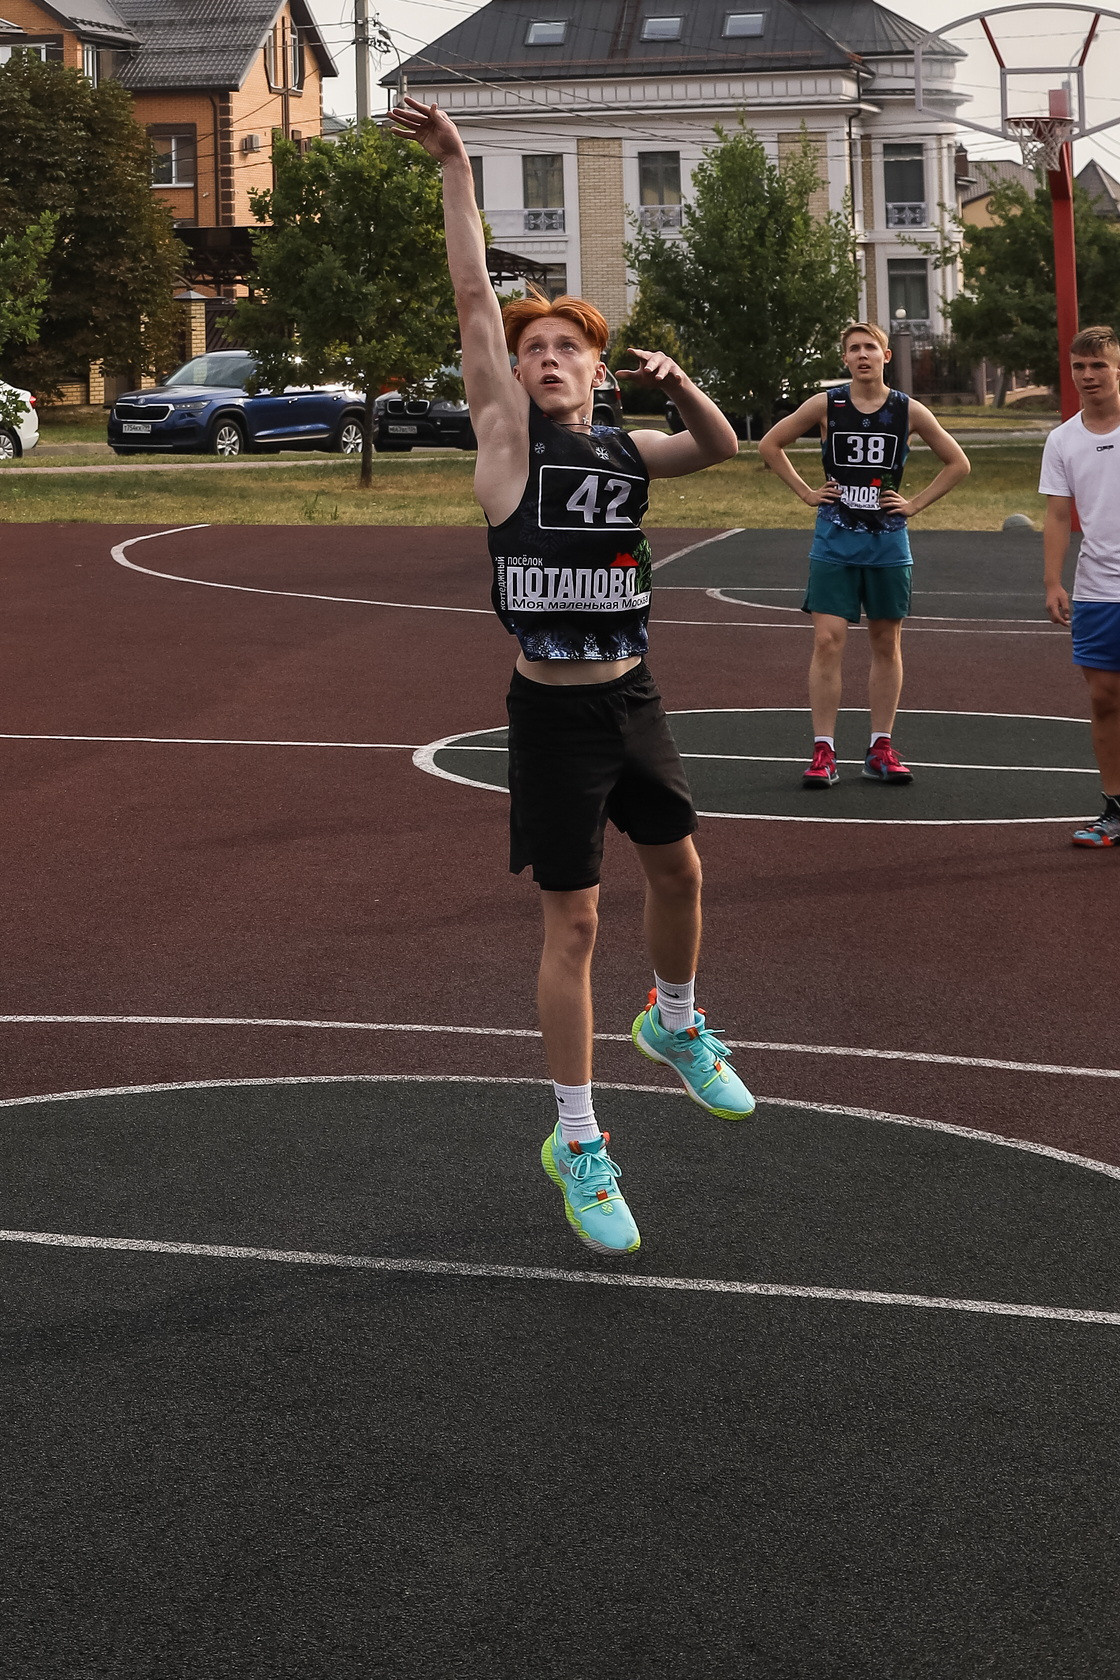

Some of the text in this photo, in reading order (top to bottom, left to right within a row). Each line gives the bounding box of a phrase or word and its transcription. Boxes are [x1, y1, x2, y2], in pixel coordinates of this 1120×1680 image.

[846, 435, 885, 464] 38
[565, 474, 633, 524] 42
[507, 554, 543, 566] посёлок
[506, 566, 637, 599] ПОТАПОВО
[512, 598, 544, 610] Моя
[548, 600, 619, 610] маленькая
